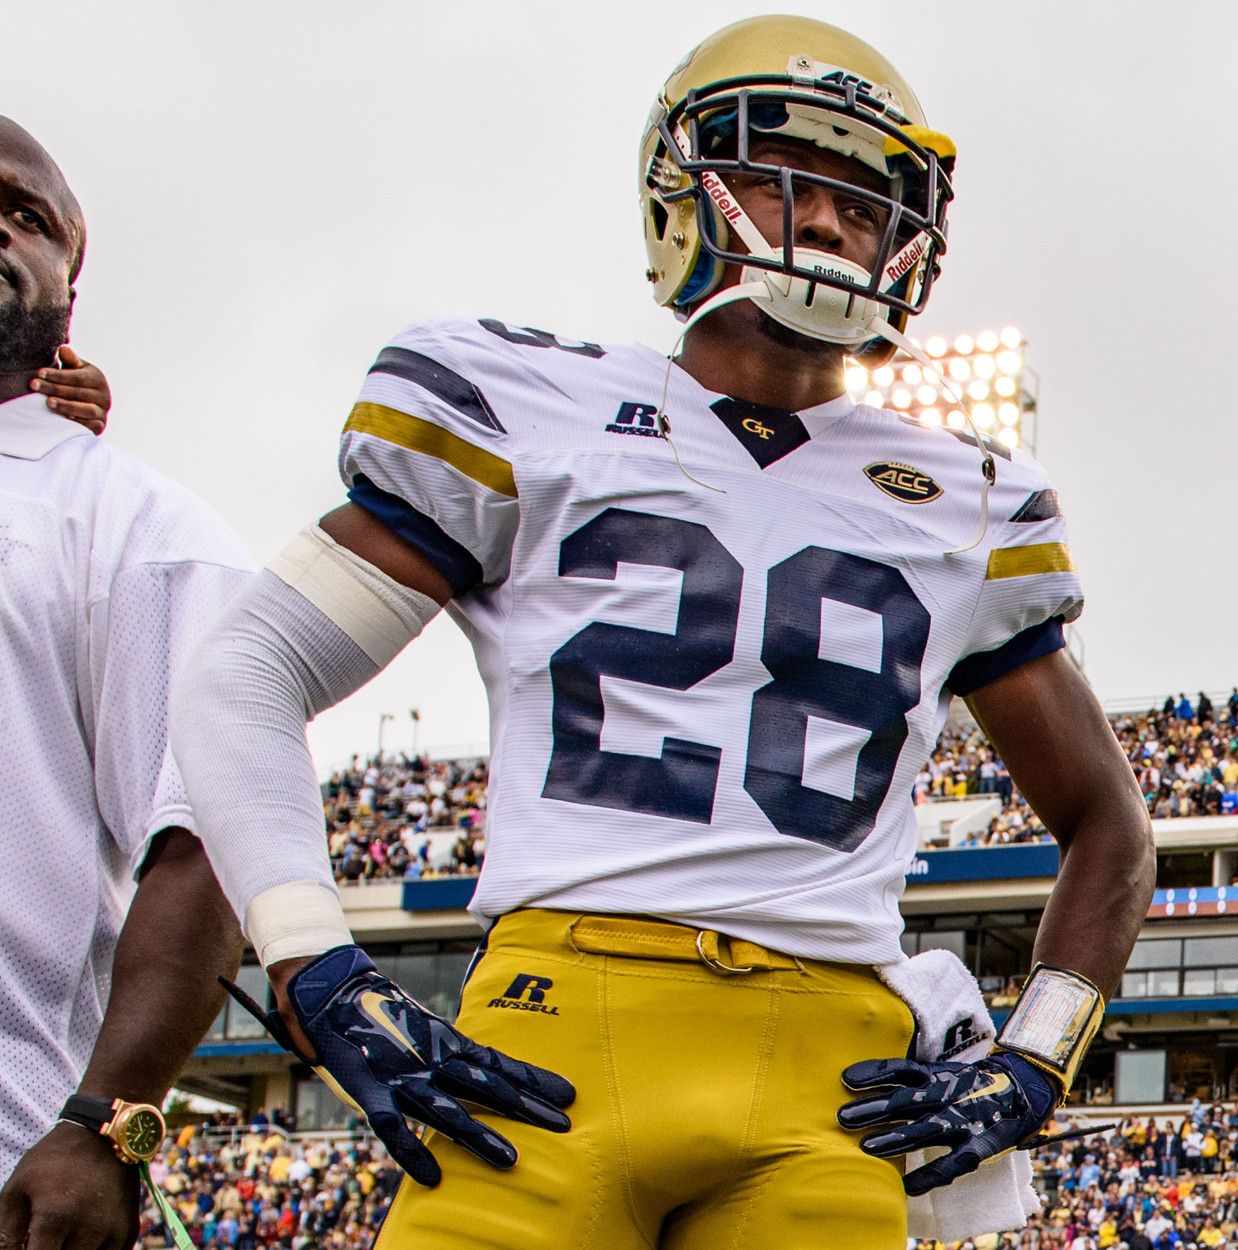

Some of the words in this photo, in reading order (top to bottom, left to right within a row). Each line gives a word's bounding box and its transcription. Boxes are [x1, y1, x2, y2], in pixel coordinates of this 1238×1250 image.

[821, 71, 875, 96] ACC
[887, 241, 924, 282] Riddell
[813, 265, 855, 284] Riddell
[877, 469, 932, 491] ACC
[541, 507, 931, 853] 28
[487, 998, 560, 1016] RUSSELL
